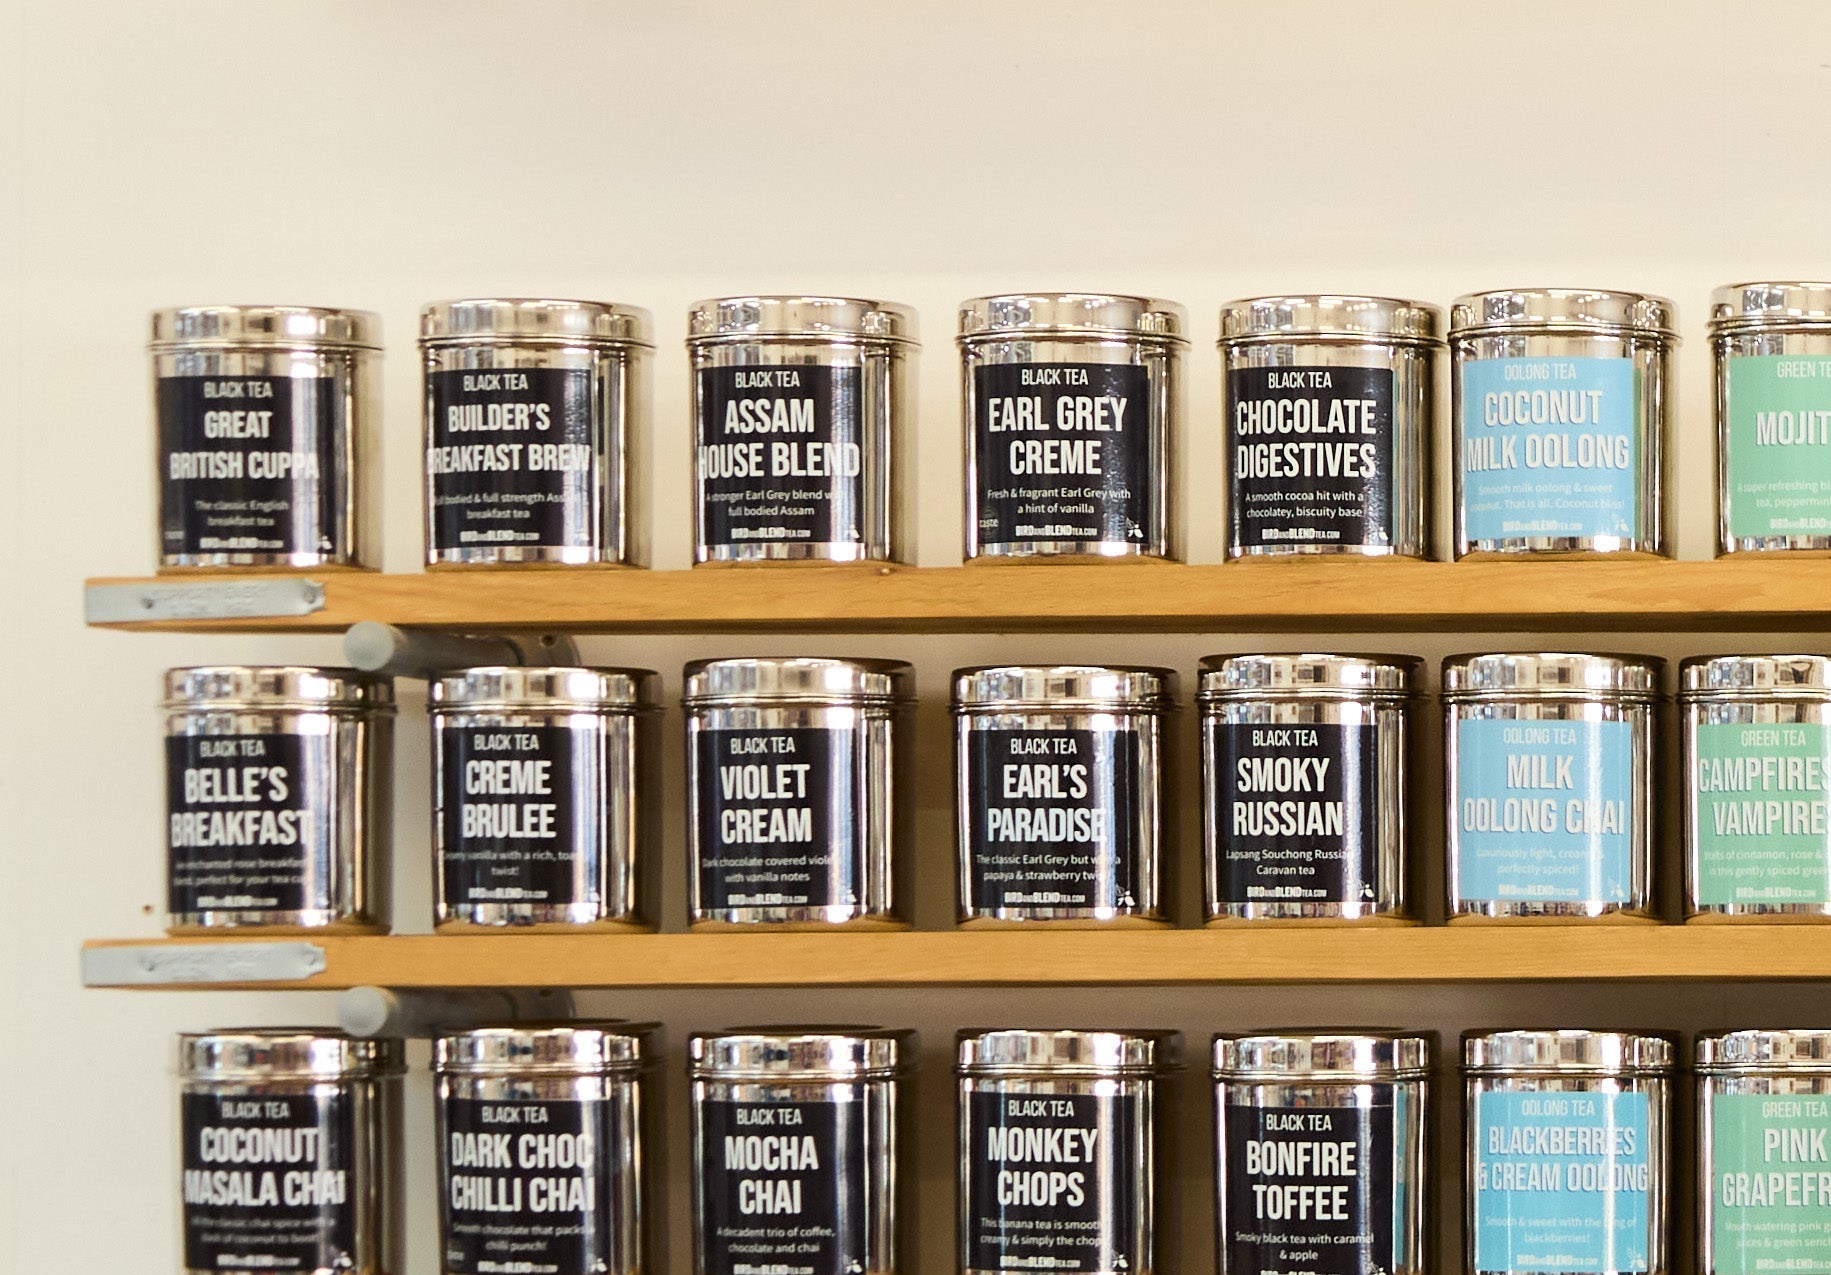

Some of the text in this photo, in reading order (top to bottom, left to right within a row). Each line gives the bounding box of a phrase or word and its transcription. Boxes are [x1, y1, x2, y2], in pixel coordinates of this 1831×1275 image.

[1022, 369, 1088, 385] BLACK TEA
[204, 411, 271, 439] GREAT
[725, 399, 814, 434] ASSAM
[989, 396, 1127, 432] EARL GREY
[1236, 399, 1376, 435] CHOCOLATE
[1484, 390, 1602, 426] COCONUT
[772, 442, 859, 478] BLEND
[1010, 440, 1102, 474] CREME
[1238, 444, 1376, 479] DIGESTIVES
[1468, 434, 1629, 471] MILK OOLONG
[1026, 503, 1094, 513] hint of vanilla
[1253, 730, 1318, 746] BLACK TEA
[1503, 727, 1576, 744] OOLONG TEA
[466, 761, 551, 795] CREME
[721, 764, 809, 798] VIOLET
[1238, 757, 1330, 792] SMOKY
[1506, 754, 1572, 791] MILK
[462, 804, 556, 839] BRULEE
[721, 808, 812, 844] CREAM
[1233, 802, 1343, 836] RUSSIAN
[1464, 798, 1557, 834] OOLONG
[1257, 865, 1315, 875] Caravan tea
[201, 1128, 318, 1164] COCONUT
[451, 1132, 592, 1169] DARK CHOC
[724, 1136, 818, 1171] MOCHA
[988, 1126, 1098, 1162] MONKEY
[1247, 1141, 1357, 1176] BONFIRE
[1763, 1128, 1828, 1164] PINK
[284, 1168, 344, 1205] CHAI
[452, 1176, 522, 1211] CHILLI
[739, 1179, 801, 1215] CHAI
[997, 1171, 1084, 1208] CHOPS
[1253, 1185, 1348, 1220] TOFFEE
[1263, 1233, 1331, 1244] black tea with
[1289, 1250, 1318, 1261] apple
